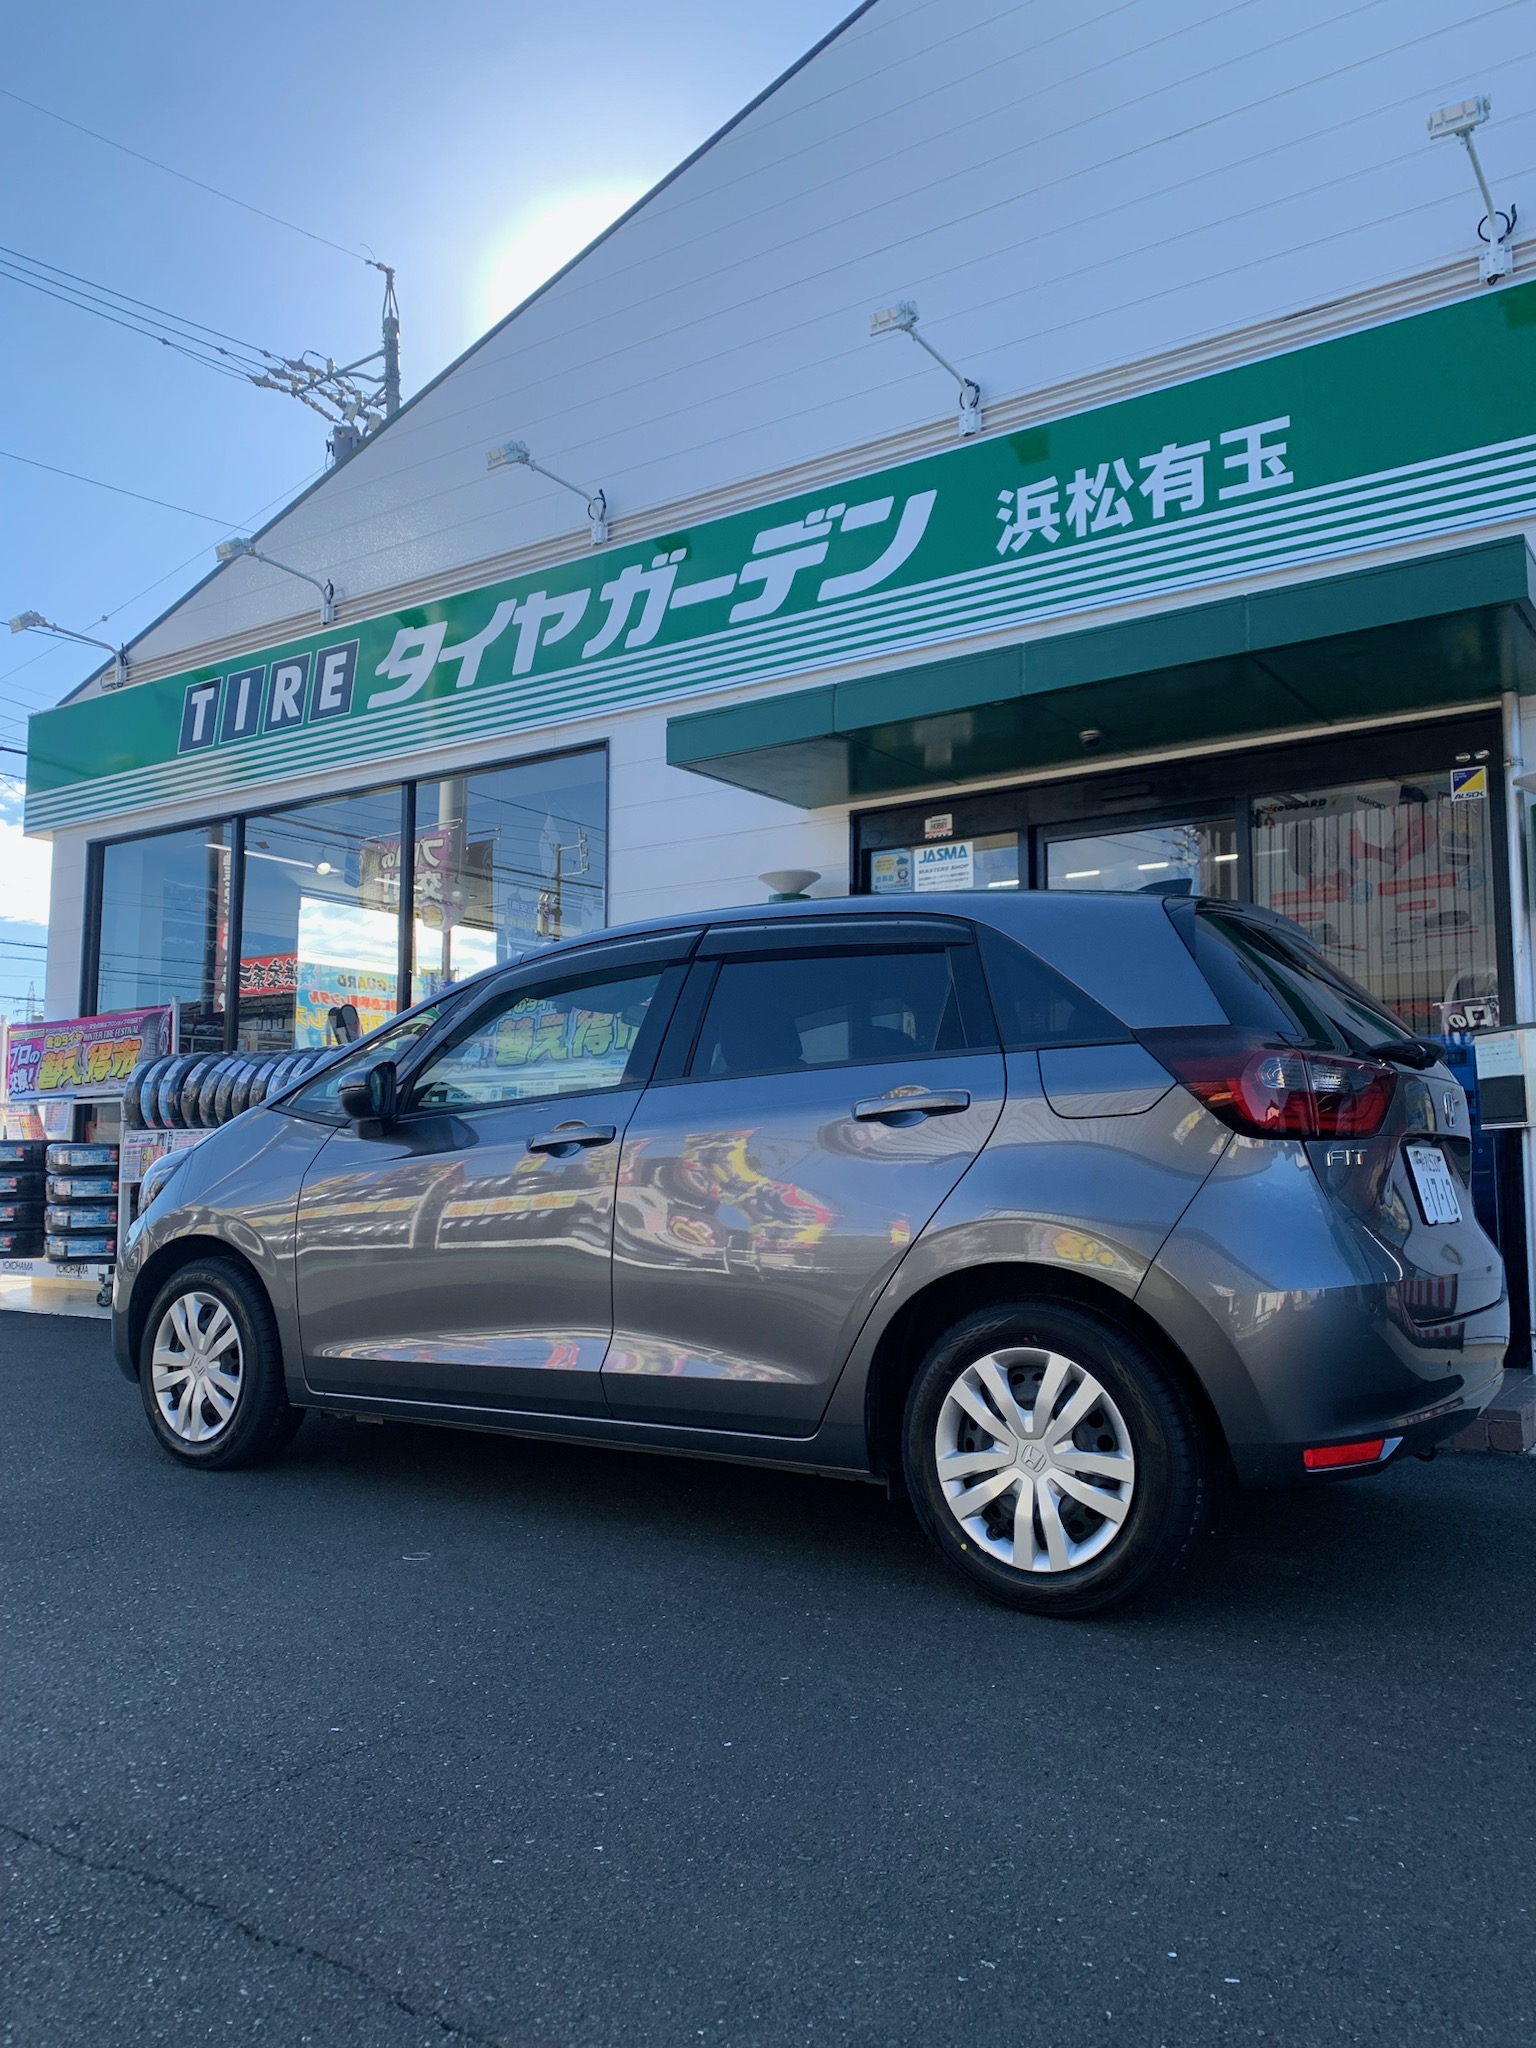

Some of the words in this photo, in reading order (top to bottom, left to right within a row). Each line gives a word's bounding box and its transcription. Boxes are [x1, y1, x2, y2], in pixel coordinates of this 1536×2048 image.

[189, 653, 352, 743] TIRE
[367, 489, 937, 710] タイヤガーデン
[996, 415, 1294, 556] 浜松有玉
[1454, 790, 1485, 800] ALSOK
[918, 845, 968, 863] JASMA
[918, 866, 949, 875] MASTERS
[950, 863, 970, 871] SHOP
[84, 1032, 103, 1042] WINTER
[103, 1030, 114, 1040] TIRE
[115, 1026, 139, 1037] FESTIVAL
[11, 1044, 40, 1068] プロの
[1326, 1149, 1368, 1167] FIT
[2, 1260, 34, 1271] YOKOHAMA
[56, 1264, 89, 1275] YOKOHAMA
